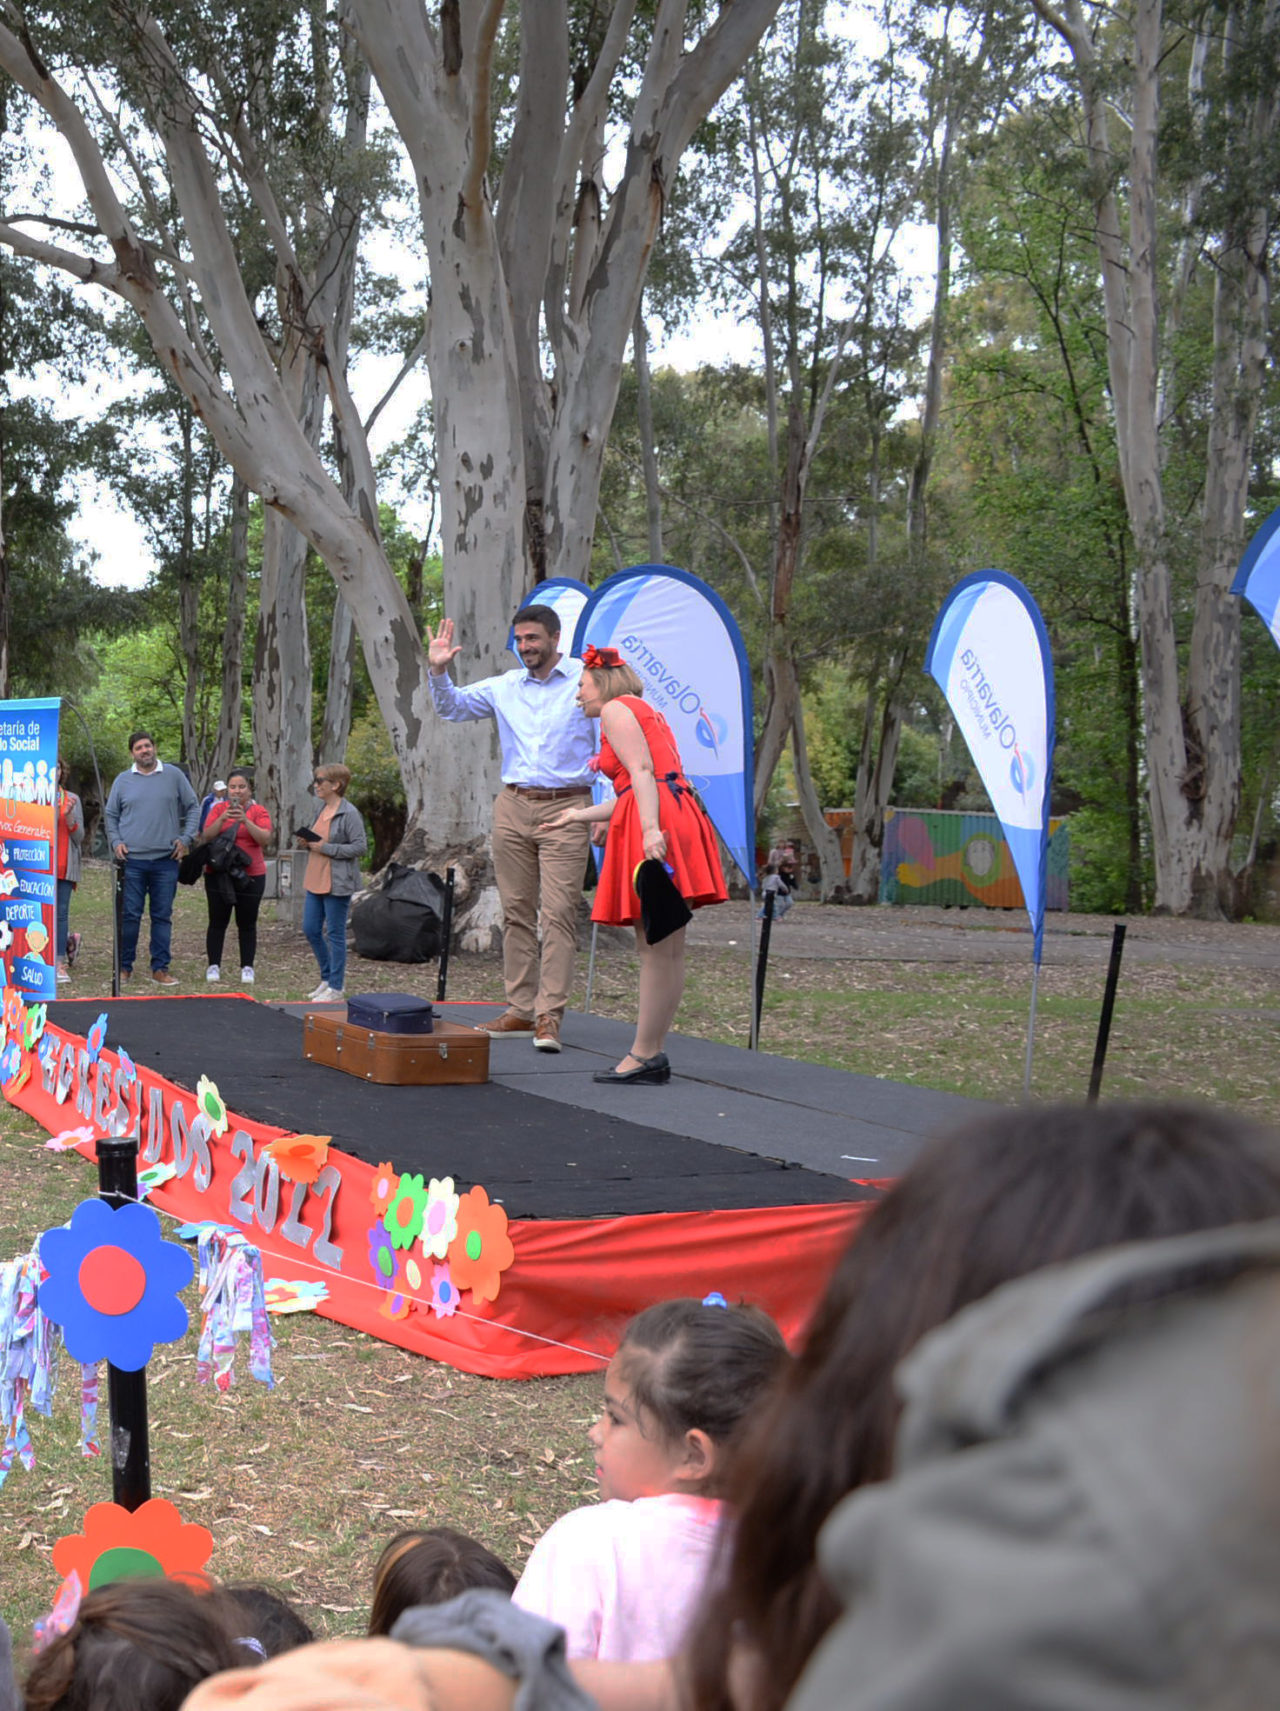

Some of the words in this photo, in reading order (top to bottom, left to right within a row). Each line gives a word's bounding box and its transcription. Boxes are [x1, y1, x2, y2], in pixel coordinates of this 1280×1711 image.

[27, 720, 40, 735] de
[9, 736, 40, 751] Social
[13, 820, 51, 839] Generales
[5, 904, 34, 920] DEPORTE
[21, 966, 43, 985] SALUD
